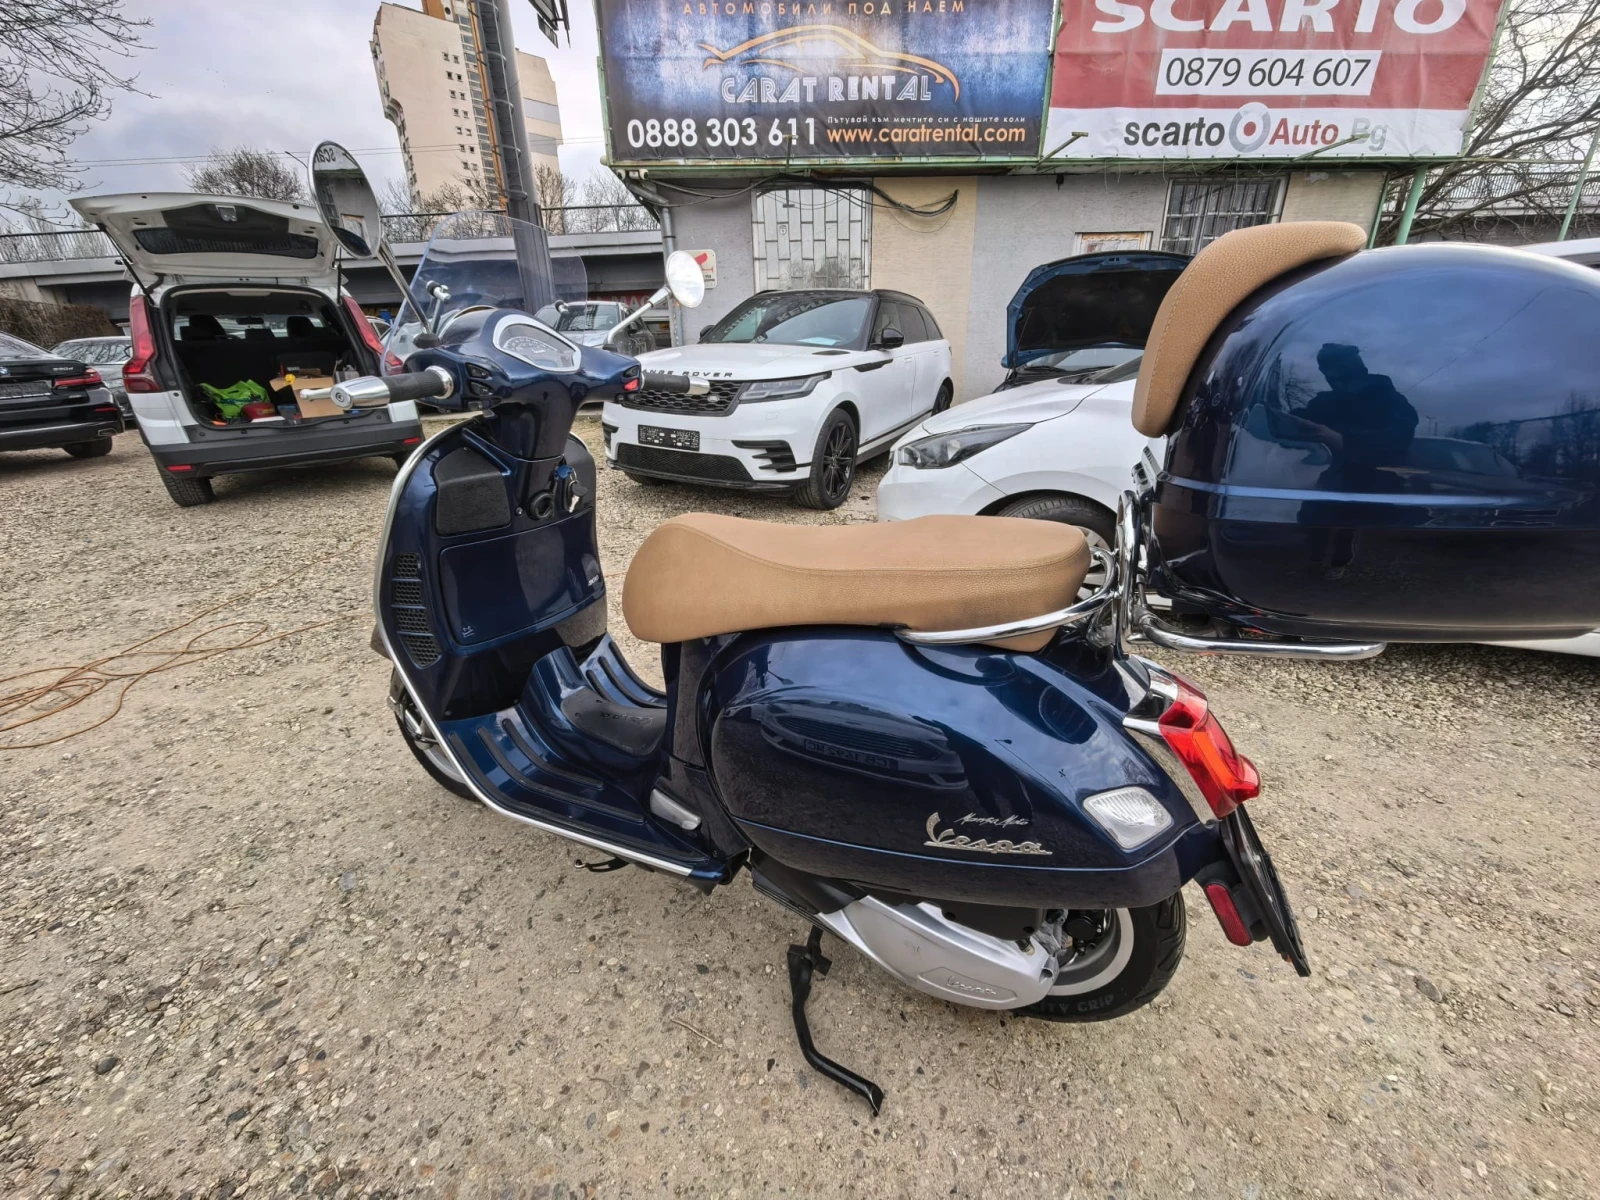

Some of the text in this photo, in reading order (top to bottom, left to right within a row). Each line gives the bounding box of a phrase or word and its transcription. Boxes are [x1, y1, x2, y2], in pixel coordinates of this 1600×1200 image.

[683, 0, 964, 15] АВТОМОБИЛИ ПОД НАЕМ
[1165, 57, 1372, 87] 0879 604 607
[721, 75, 932, 103] CARAT RENTAL
[827, 115, 868, 124] Пътувай
[627, 117, 815, 148] 0888 303 611
[826, 124, 1026, 142] www.caratrental.com
[1123, 117, 1388, 151] scarto Auto Bg
[924, 812, 1053, 855] Vespa
[947, 975, 997, 995] Vespa
[1077, 994, 1115, 1012] GRIP
